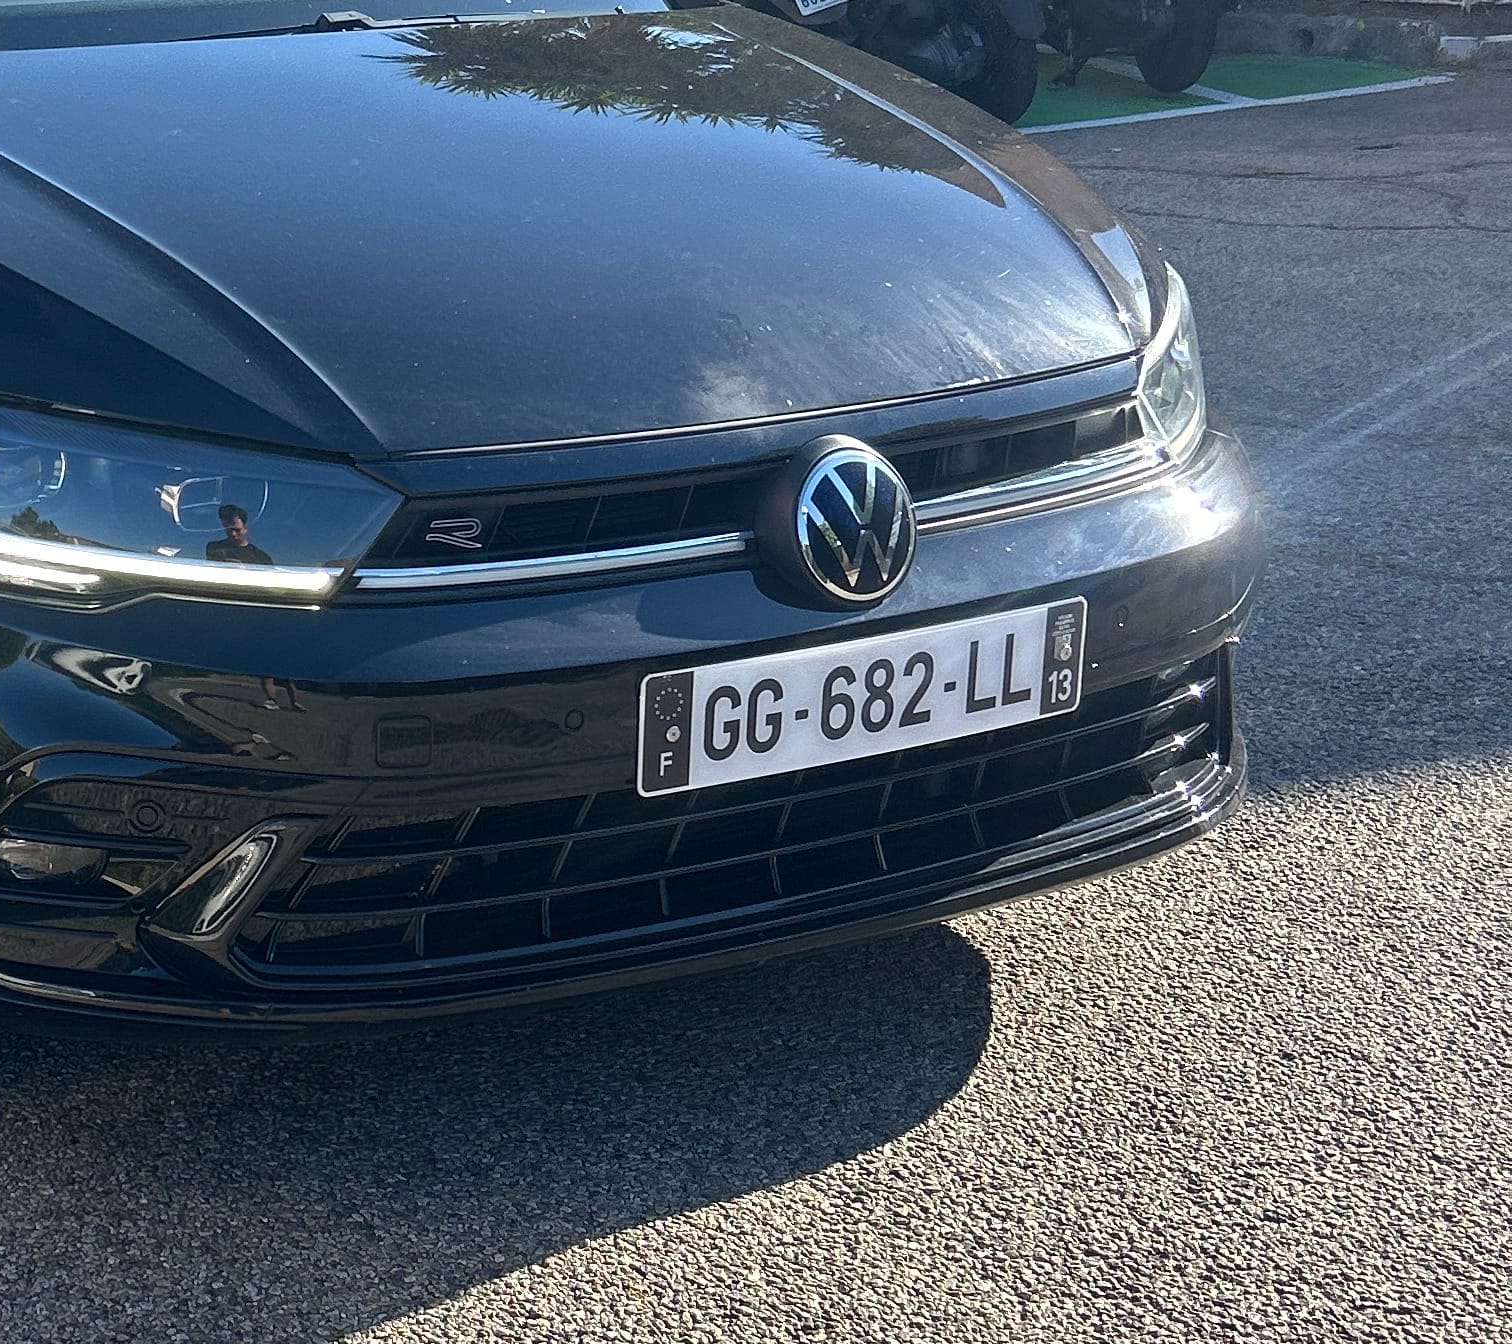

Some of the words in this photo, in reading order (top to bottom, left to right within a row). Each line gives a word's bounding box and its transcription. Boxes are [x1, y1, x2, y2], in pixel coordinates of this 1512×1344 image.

[703, 633, 1032, 762] GG-682-LL
[1048, 668, 1073, 704] 13
[659, 751, 674, 777] F
